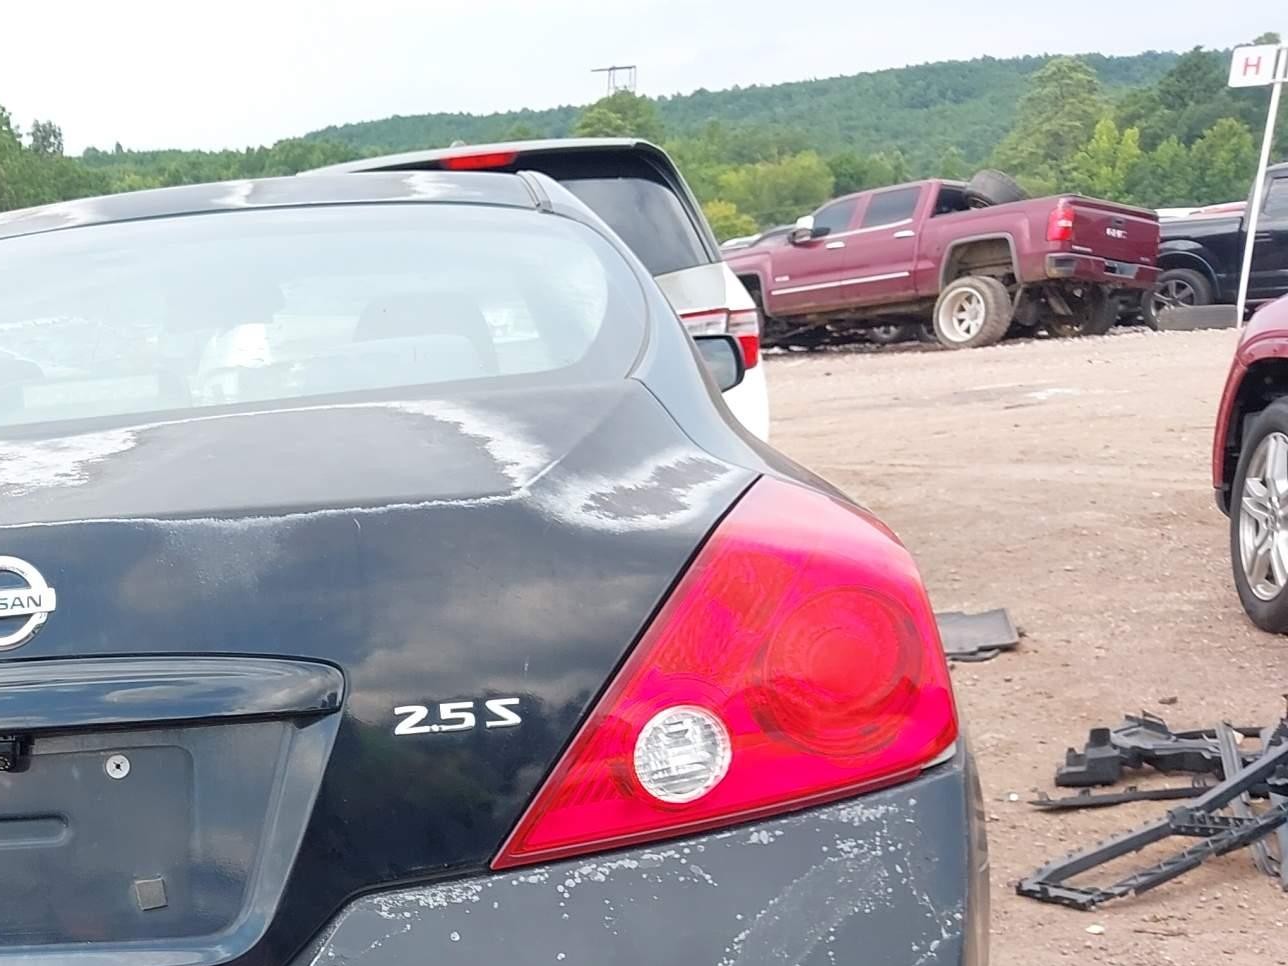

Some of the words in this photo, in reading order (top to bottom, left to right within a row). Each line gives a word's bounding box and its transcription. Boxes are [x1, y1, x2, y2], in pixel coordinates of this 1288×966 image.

[1243, 57, 1262, 76] H
[394, 701, 476, 736] 2.5
[485, 697, 523, 729] S
